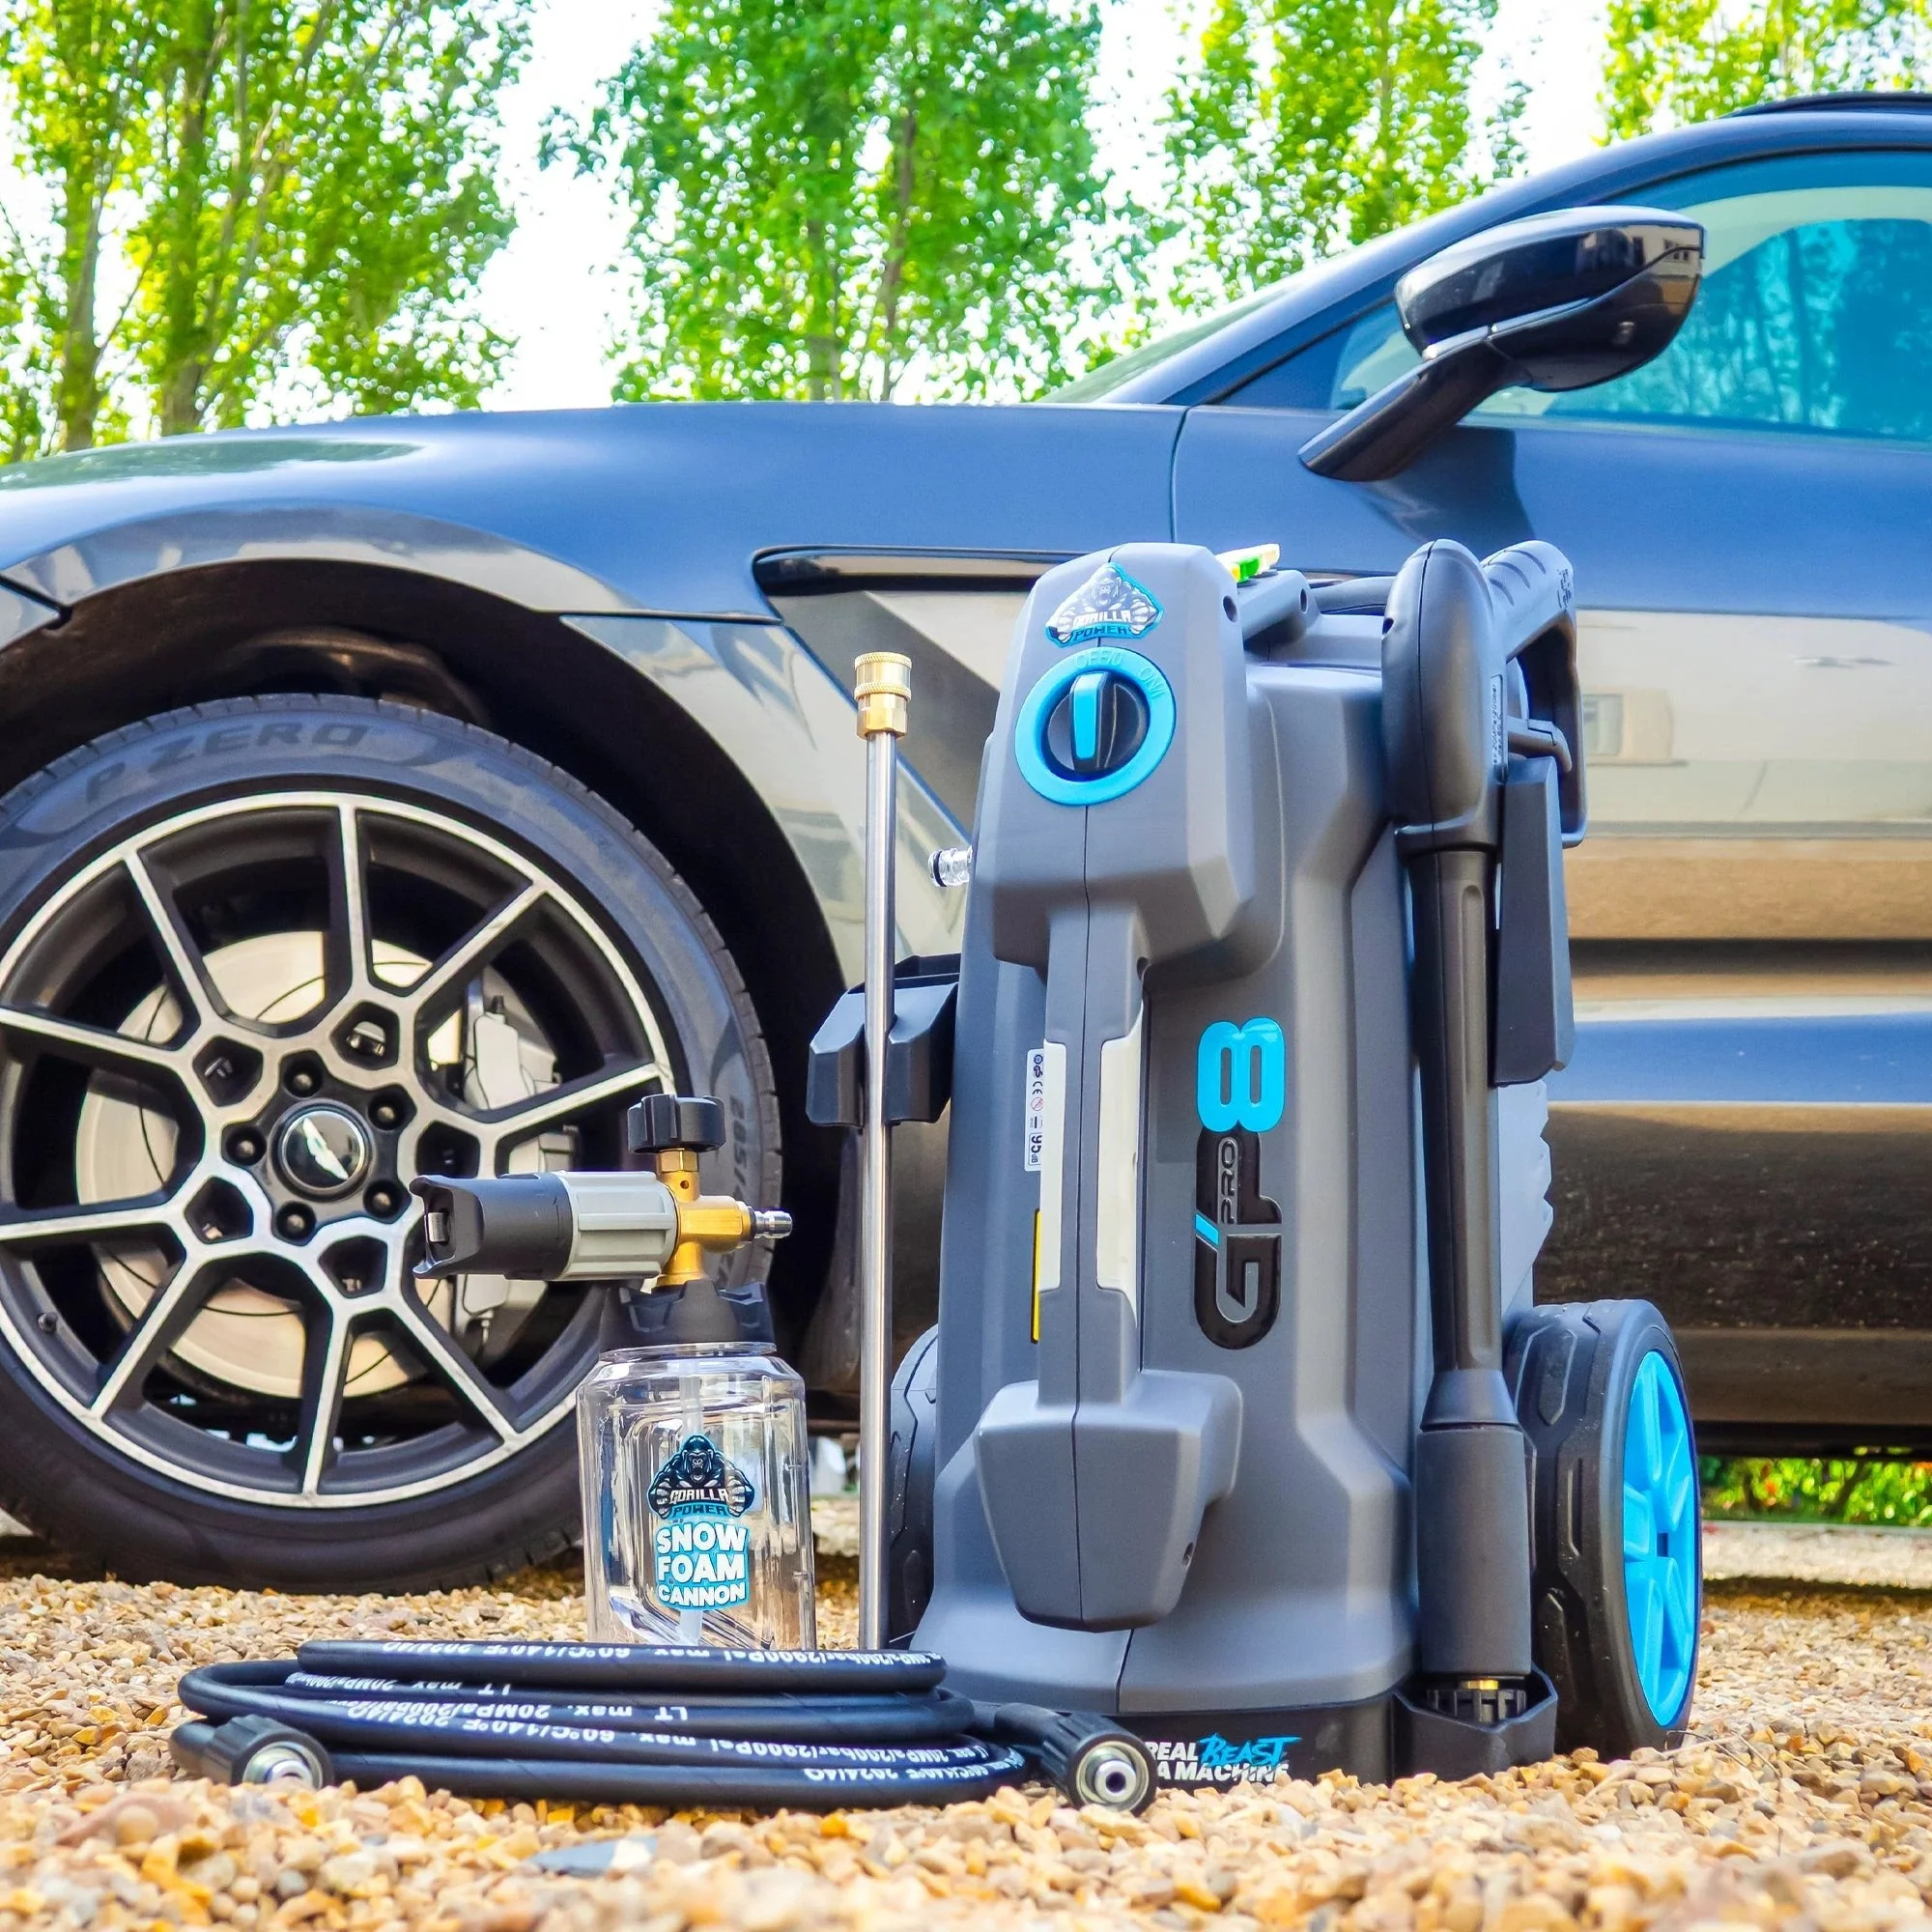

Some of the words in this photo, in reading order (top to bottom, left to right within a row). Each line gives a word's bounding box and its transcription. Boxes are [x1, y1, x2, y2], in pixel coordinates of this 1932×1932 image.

[1072, 610, 1132, 628] GORILLA
[1074, 625, 1128, 639] POWER
[86, 761, 126, 804] P
[148, 722, 370, 775] ZERO
[1220, 1140, 1236, 1224] PRO
[669, 1488, 729, 1505] GORILLA
[671, 1504, 728, 1518] POWER
[657, 1521, 748, 1554] SNOW
[658, 1553, 746, 1583] FOAM
[658, 1581, 747, 1607] CANNON
[654, 1706, 688, 1720] LT
[1144, 1742, 1198, 1761] REAL
[1199, 1732, 1302, 1767] BEAST
